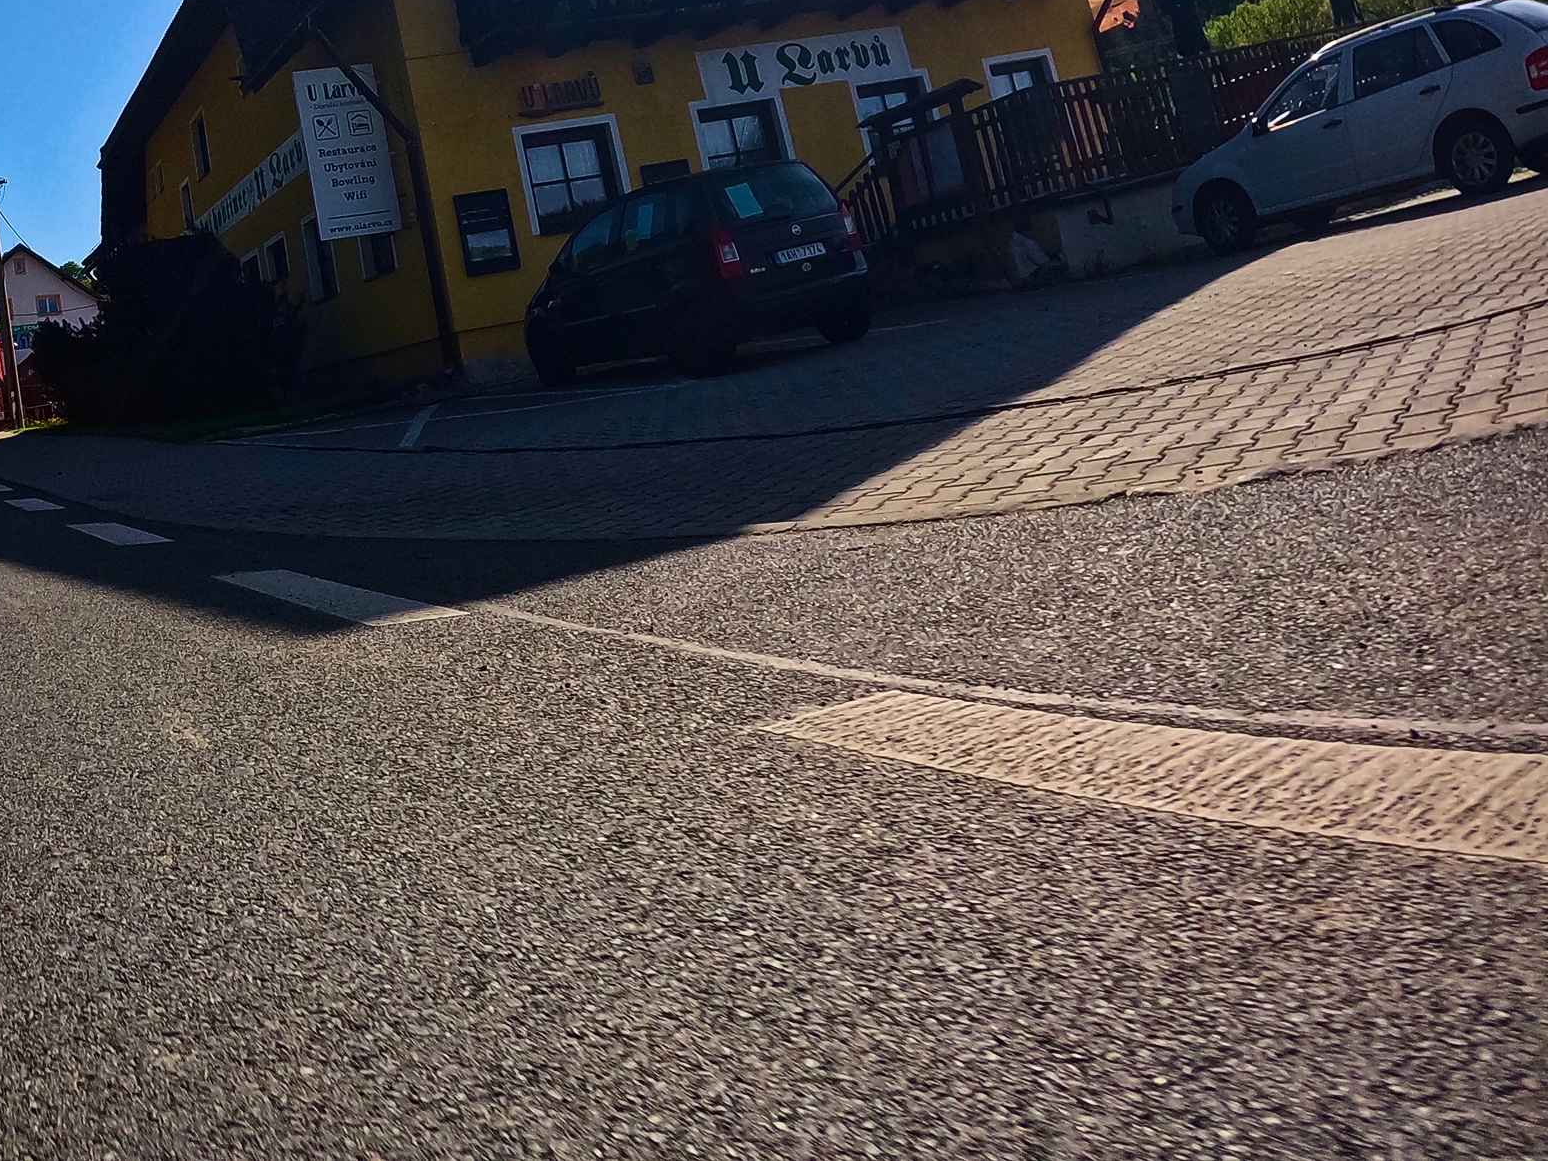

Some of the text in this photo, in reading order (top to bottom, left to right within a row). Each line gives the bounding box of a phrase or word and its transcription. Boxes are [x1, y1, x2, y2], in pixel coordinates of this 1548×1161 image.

[722, 32, 892, 96] U Larvů
[307, 83, 318, 102] U
[318, 143, 378, 158] Restaurace
[322, 158, 378, 173] Ubytování
[331, 174, 376, 188] Bowling
[343, 189, 369, 202] Wifi
